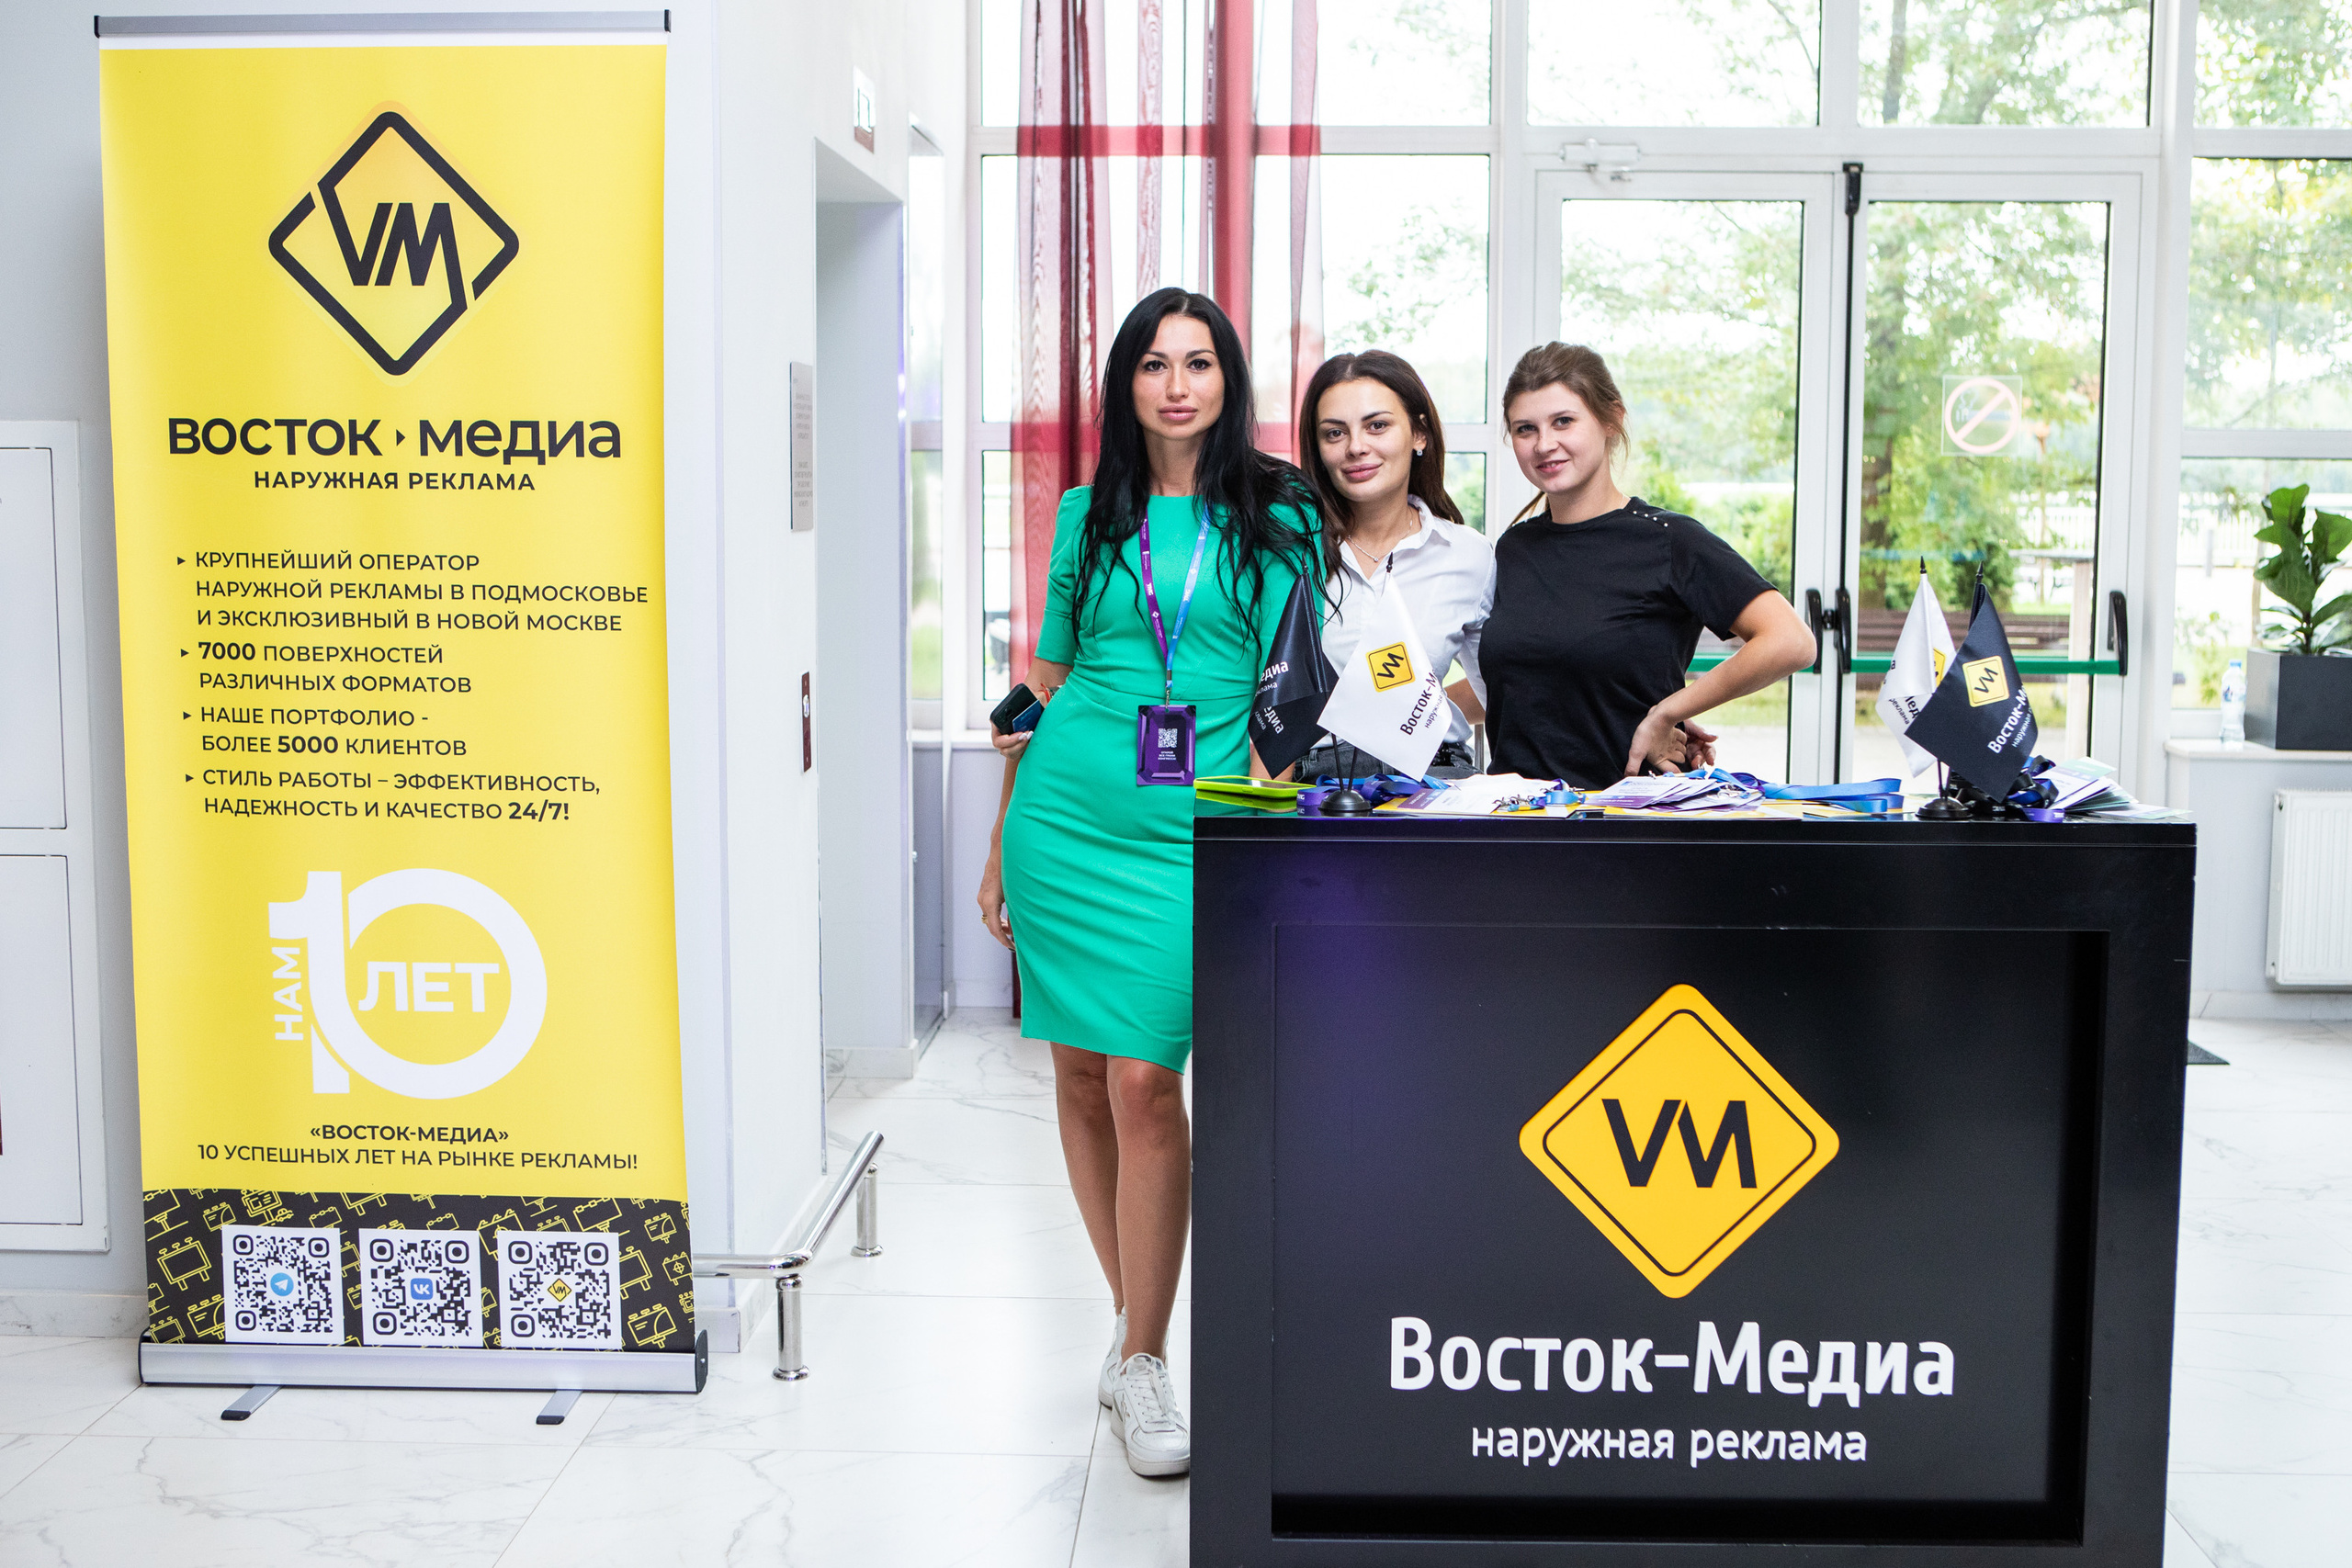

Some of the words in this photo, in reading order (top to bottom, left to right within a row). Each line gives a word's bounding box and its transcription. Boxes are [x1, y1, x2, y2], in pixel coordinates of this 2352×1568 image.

[319, 186, 467, 301] VM
[254, 471, 398, 489] НАРУЖНАЯ
[409, 473, 535, 490] РЕКЛАМА
[197, 550, 351, 569] КРУПНЕЙШИЙ
[360, 554, 479, 570] ОПЕРАТОР
[197, 580, 322, 598] НАРУЖНОЙ
[331, 583, 442, 599] РЕКЛАМЫ
[451, 584, 464, 599] В
[472, 585, 647, 604] ПОДМОСКОВЬЕ
[198, 610, 210, 625] И
[218, 610, 407, 628] ЭКСКЛЮЗИВНЫЙ
[417, 614, 429, 628] В
[438, 611, 518, 629] НОВОЙ
[527, 615, 621, 630] МОСКВЕ
[198, 642, 255, 660] 7000
[265, 645, 442, 663] ПОВЕРХНОСТЕЙ
[1377, 652, 1405, 679] VM
[200, 673, 335, 690] РАЗЛИЧНЫХ
[343, 675, 470, 692] ФОРМАТОВ
[1974, 667, 1998, 694] VM
[1400, 671, 1438, 736] Восток-М
[201, 707, 264, 723] НАШЕ
[271, 709, 414, 726] ПОРТФОЛИО
[1987, 683, 2027, 753] Восток-М
[203, 736, 271, 752] БОЛЕЕ
[278, 736, 338, 753] 5000
[346, 739, 466, 755] КЛИЕНТОВ
[203, 770, 272, 786] СТИЛЬ
[279, 772, 370, 787] РАБОТЫ
[394, 773, 599, 794] ЭФФЕКТИВНОСТЬ,
[205, 798, 357, 817] НАДЕЖНОСТЬ
[366, 802, 378, 817] И
[387, 803, 502, 818] КАЧЕСТВО
[509, 799, 569, 821] 24/7!
[268, 868, 548, 1100] 10
[272, 947, 303, 1040] НАМ
[358, 962, 500, 1012] ЛЕТ
[311, 1125, 508, 1145] «ВОСТОК-МЕДИА»
[1602, 1100, 1757, 1188] VM
[198, 1145, 218, 1159] 10
[224, 1145, 349, 1163] УСПЕШНЫХ
[356, 1149, 395, 1164] ЛЕТ
[402, 1150, 432, 1165] НА
[439, 1151, 514, 1167] РЫНКЕ
[522, 1153, 636, 1168] РЕКЛАМЫ!
[1473, 1427, 1674, 1466] наружная
[1690, 1429, 1866, 1468] реклама
